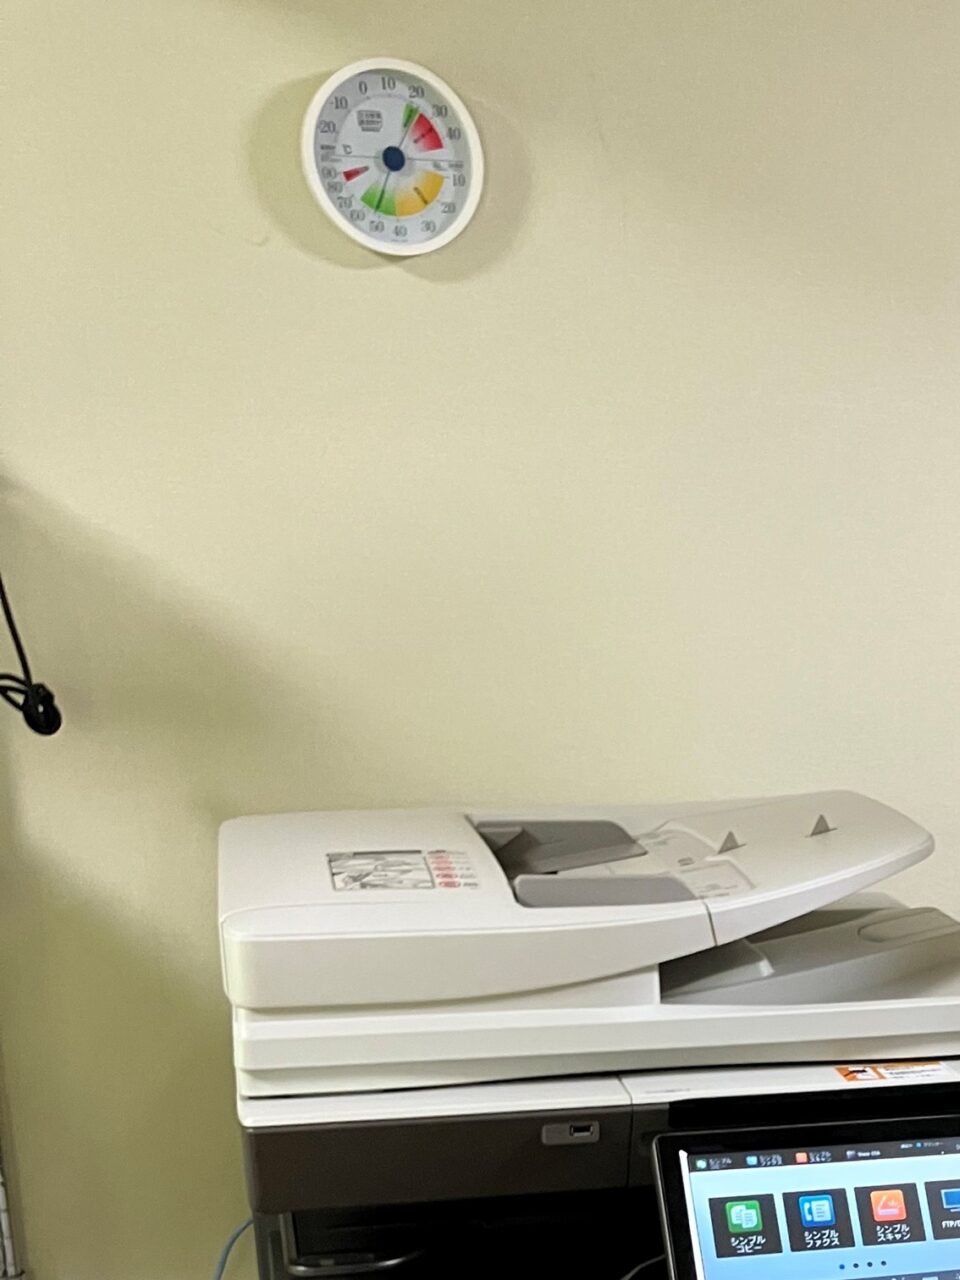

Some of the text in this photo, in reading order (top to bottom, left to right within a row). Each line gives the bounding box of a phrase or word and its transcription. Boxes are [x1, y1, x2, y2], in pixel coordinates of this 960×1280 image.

[358, 81, 368, 95] 0
[381, 77, 396, 90] 10
[408, 86, 424, 98] 20
[433, 104, 448, 117] 30
[876, 1223, 910, 1234] シンプル
[730, 1235, 766, 1247] シンプル
[804, 1229, 839, 1241] シンプル
[877, 1231, 911, 1242] スキャン
[805, 1238, 840, 1248] ファクス
